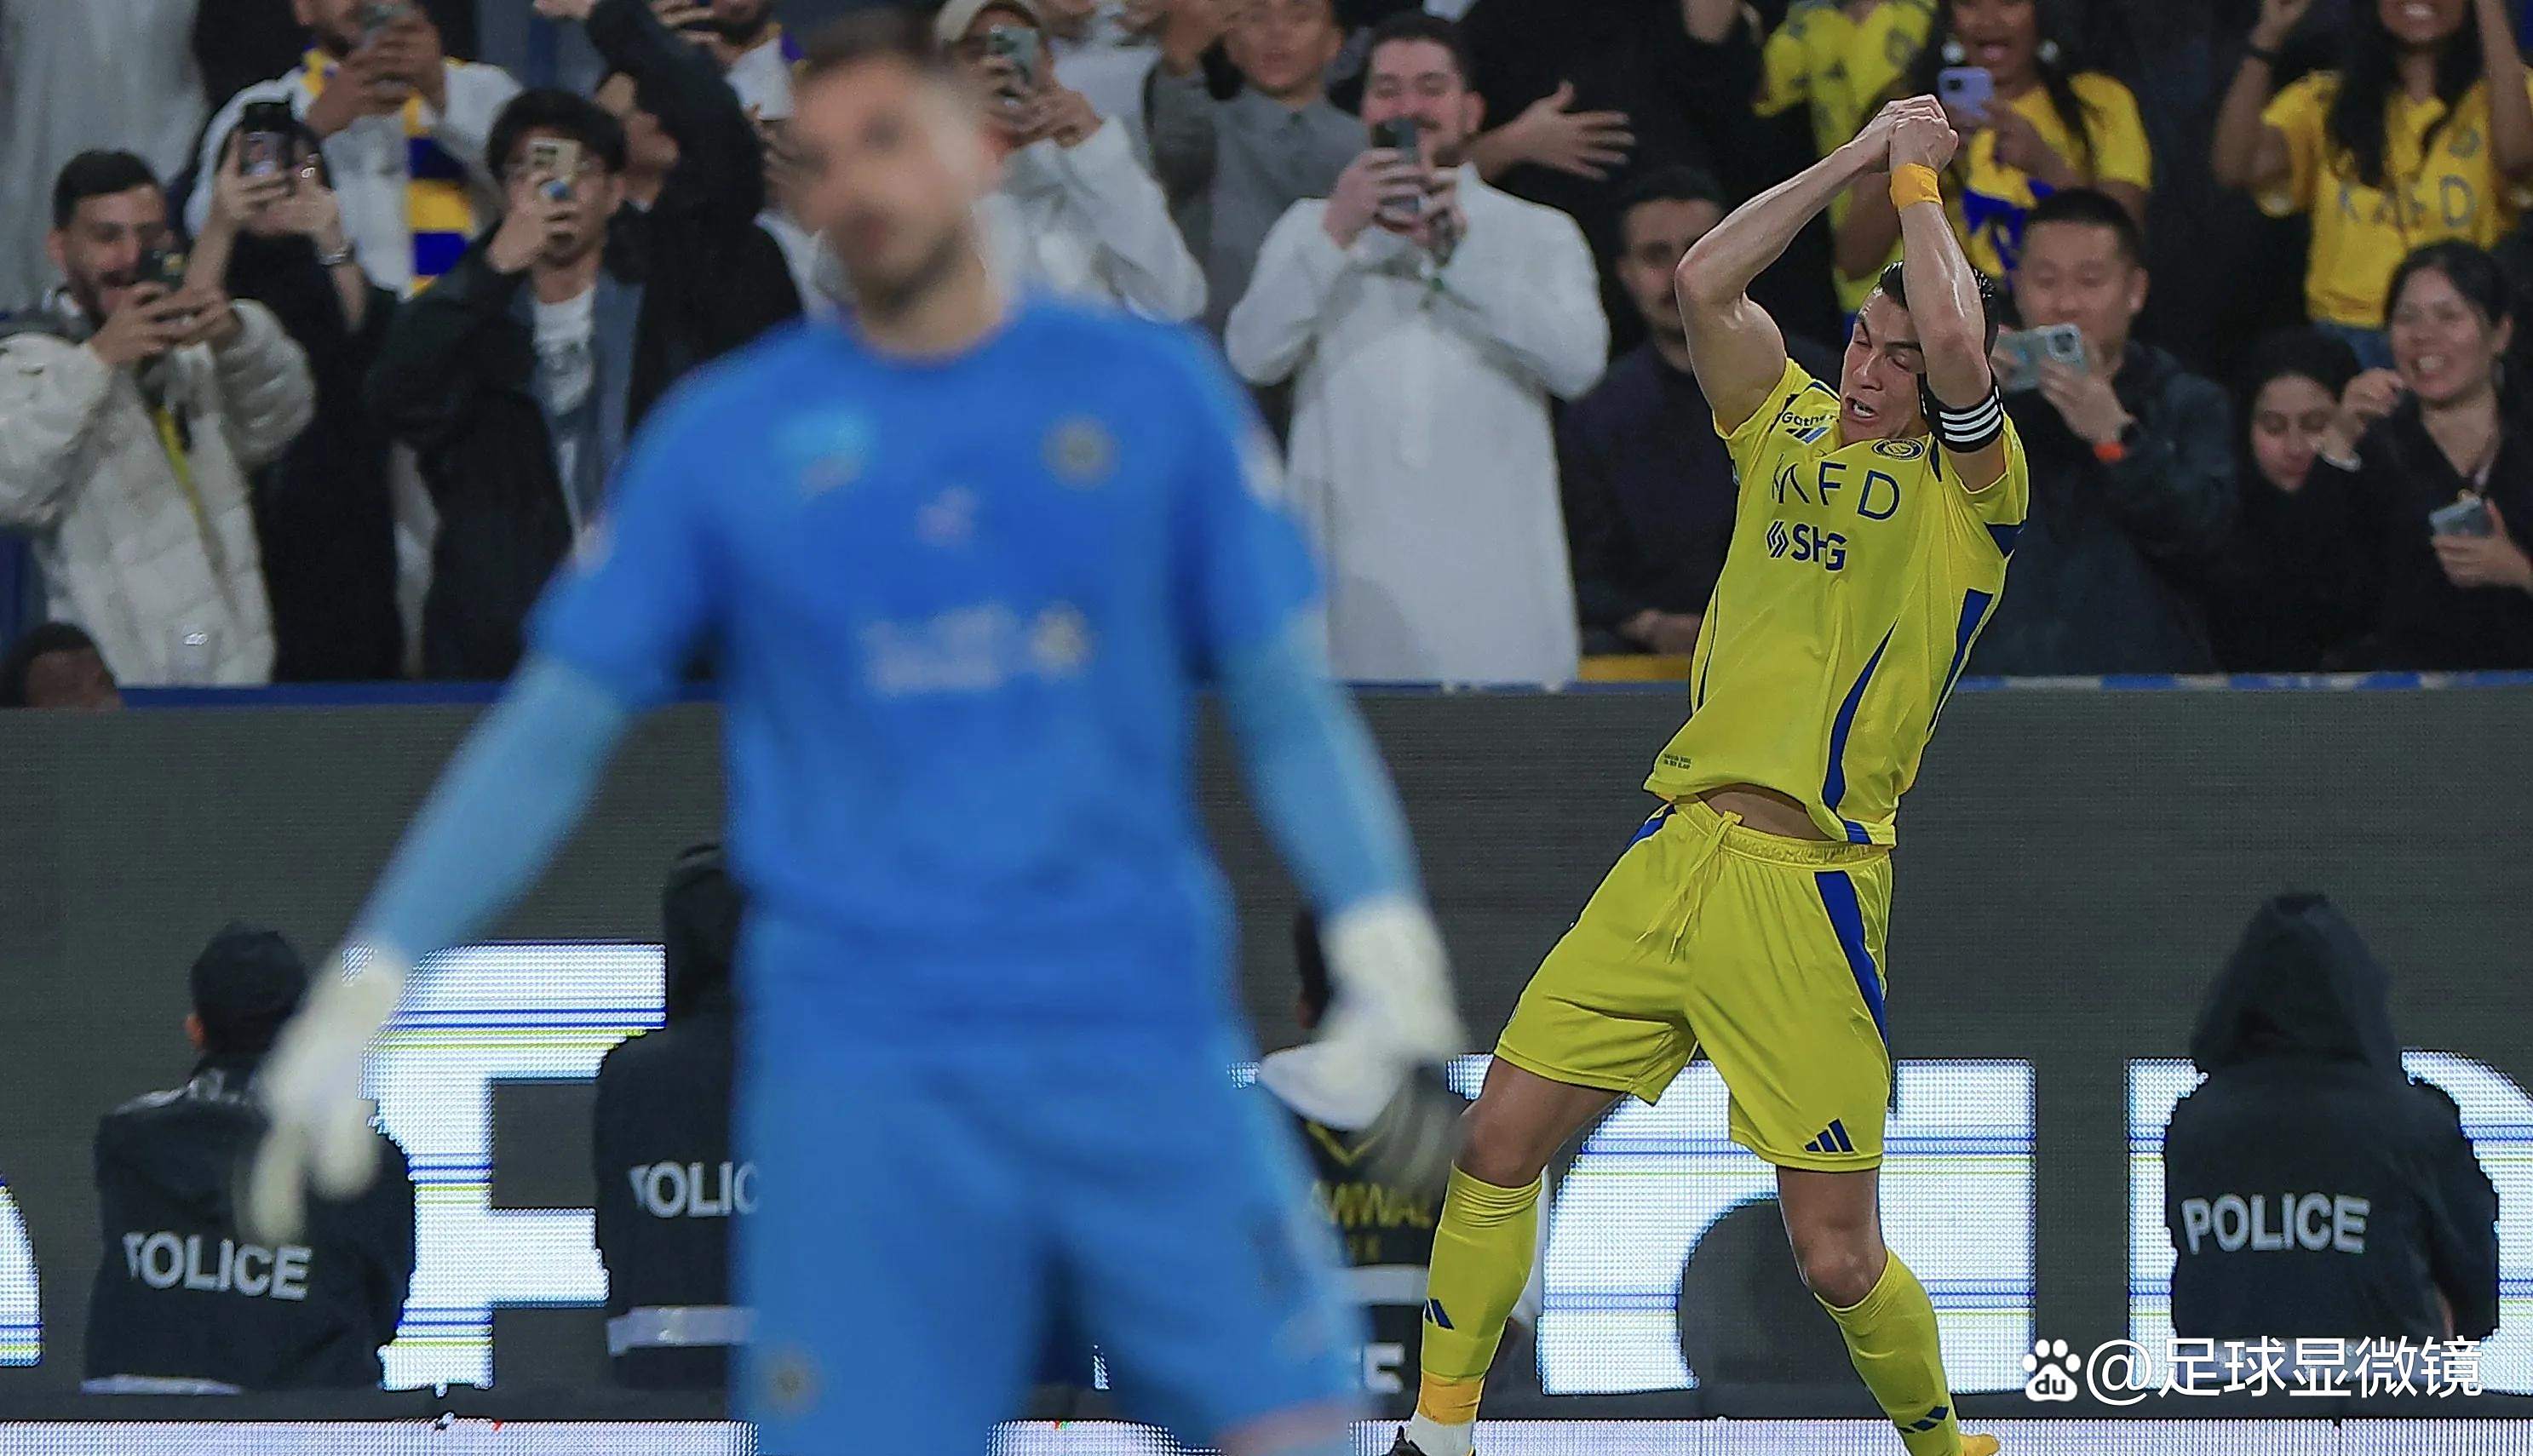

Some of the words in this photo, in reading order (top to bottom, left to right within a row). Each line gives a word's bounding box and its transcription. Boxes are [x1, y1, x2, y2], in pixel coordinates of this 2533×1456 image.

[1790, 523, 1847, 571] SHG
[628, 1161, 759, 1218] OLIC
[2181, 1192, 2371, 1255] POLICE
